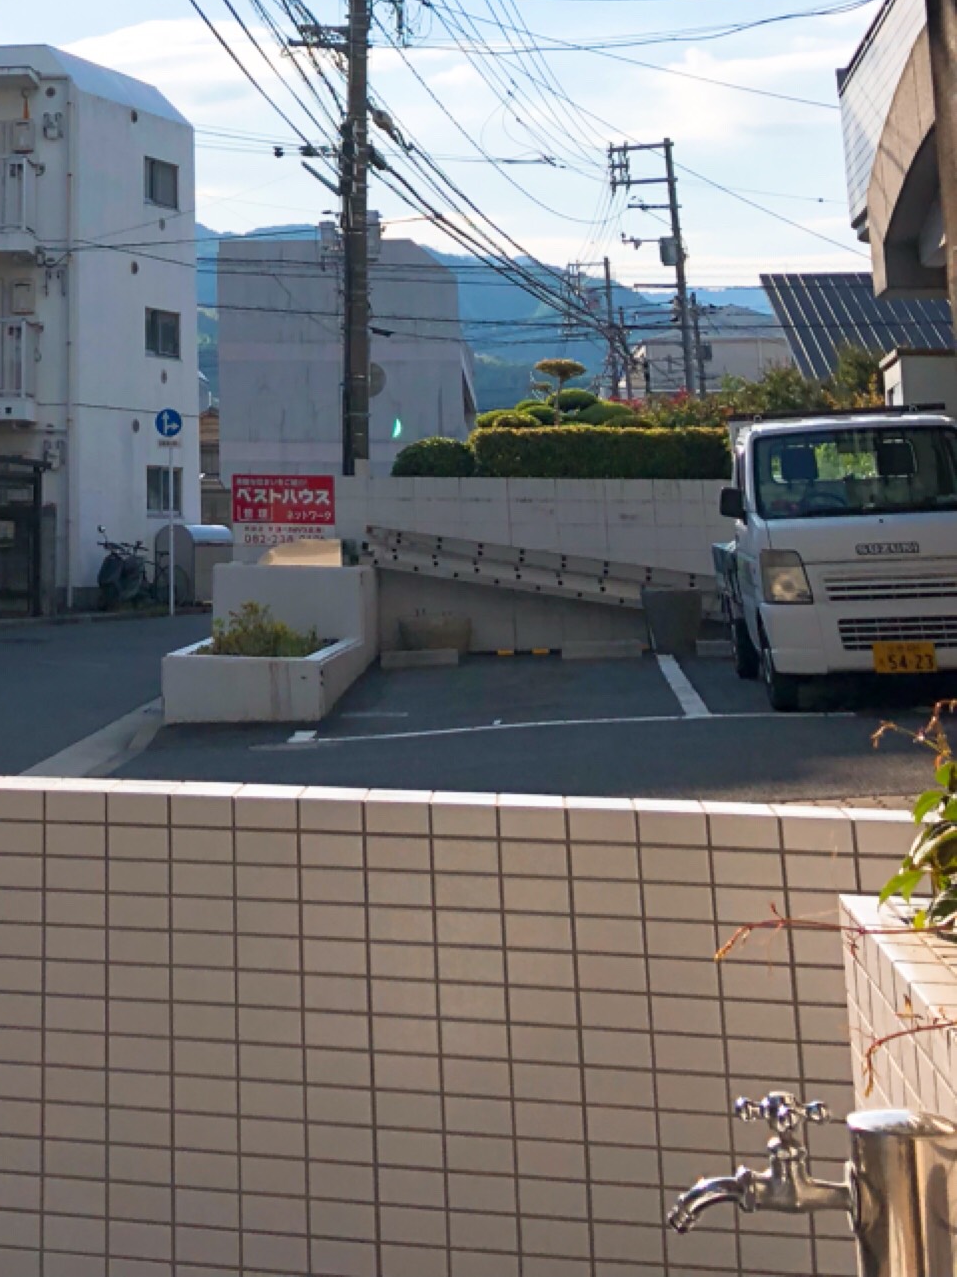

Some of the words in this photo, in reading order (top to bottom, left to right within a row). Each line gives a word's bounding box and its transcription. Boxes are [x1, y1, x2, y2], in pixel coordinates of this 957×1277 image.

[237, 487, 330, 504] ベストハウス
